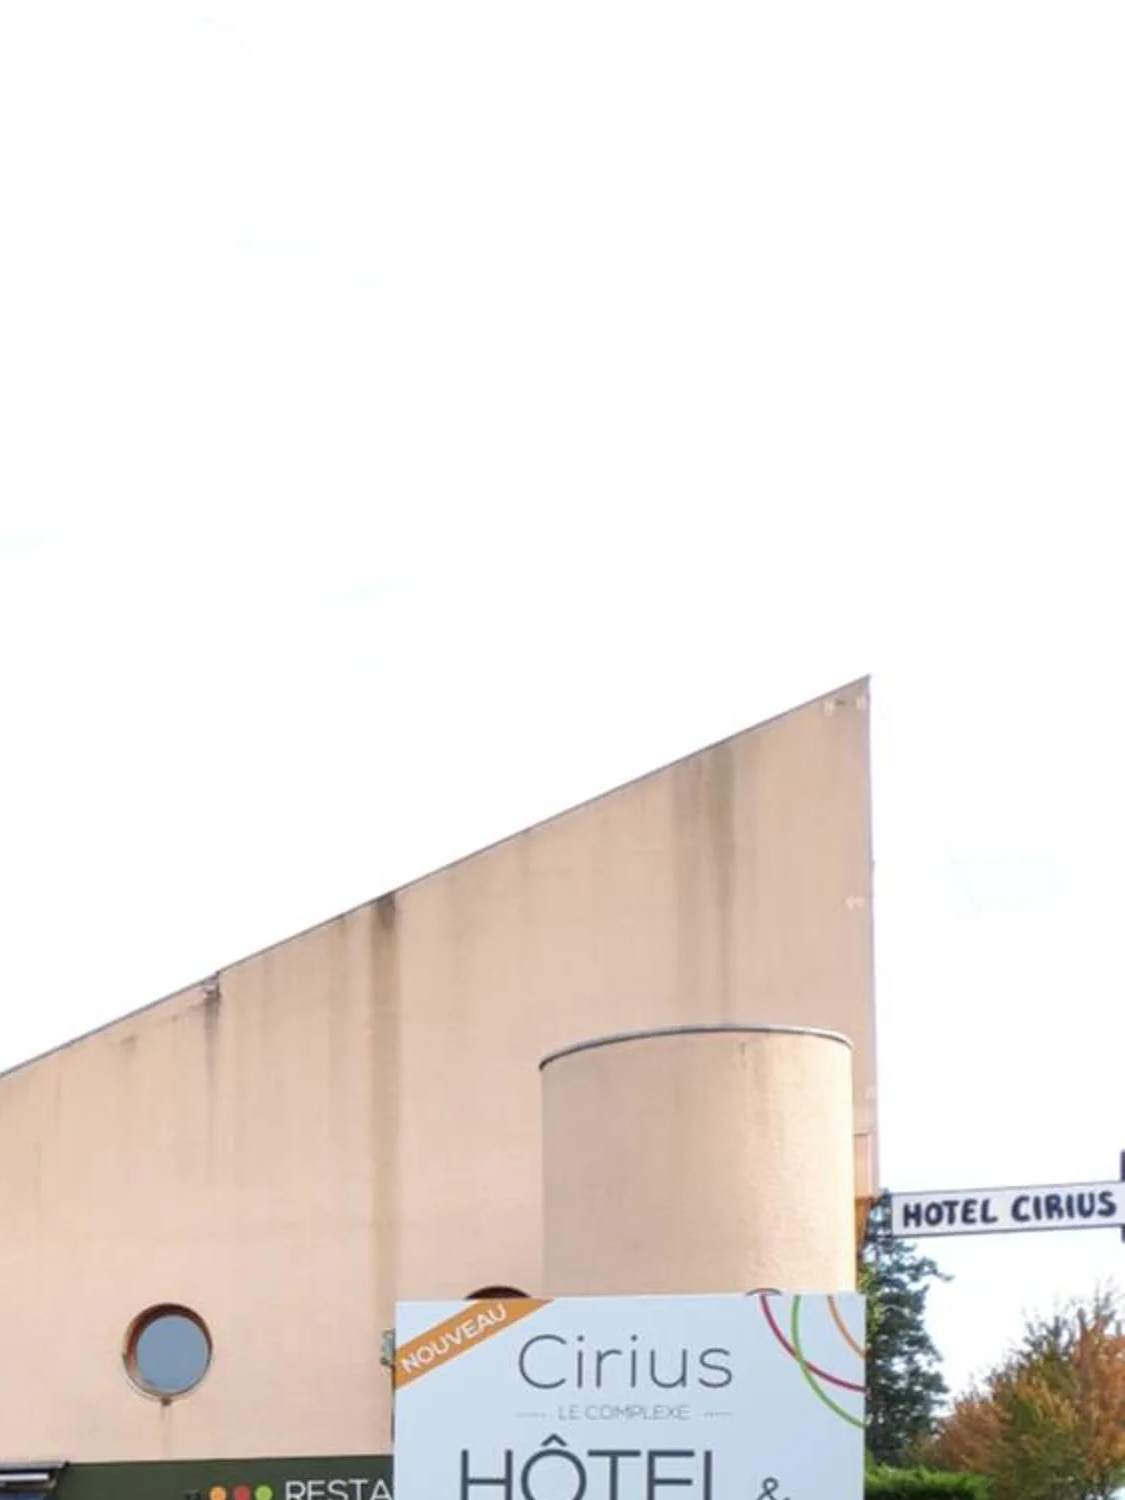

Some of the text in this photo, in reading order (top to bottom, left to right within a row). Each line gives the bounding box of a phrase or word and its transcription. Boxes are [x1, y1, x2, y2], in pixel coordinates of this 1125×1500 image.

[901, 1190, 1118, 1229] HOTEL CIRIUS
[399, 1302, 509, 1374] NOUVEAU
[517, 1333, 735, 1389] Cirius
[557, 1403, 692, 1421] LE COMPLEXE
